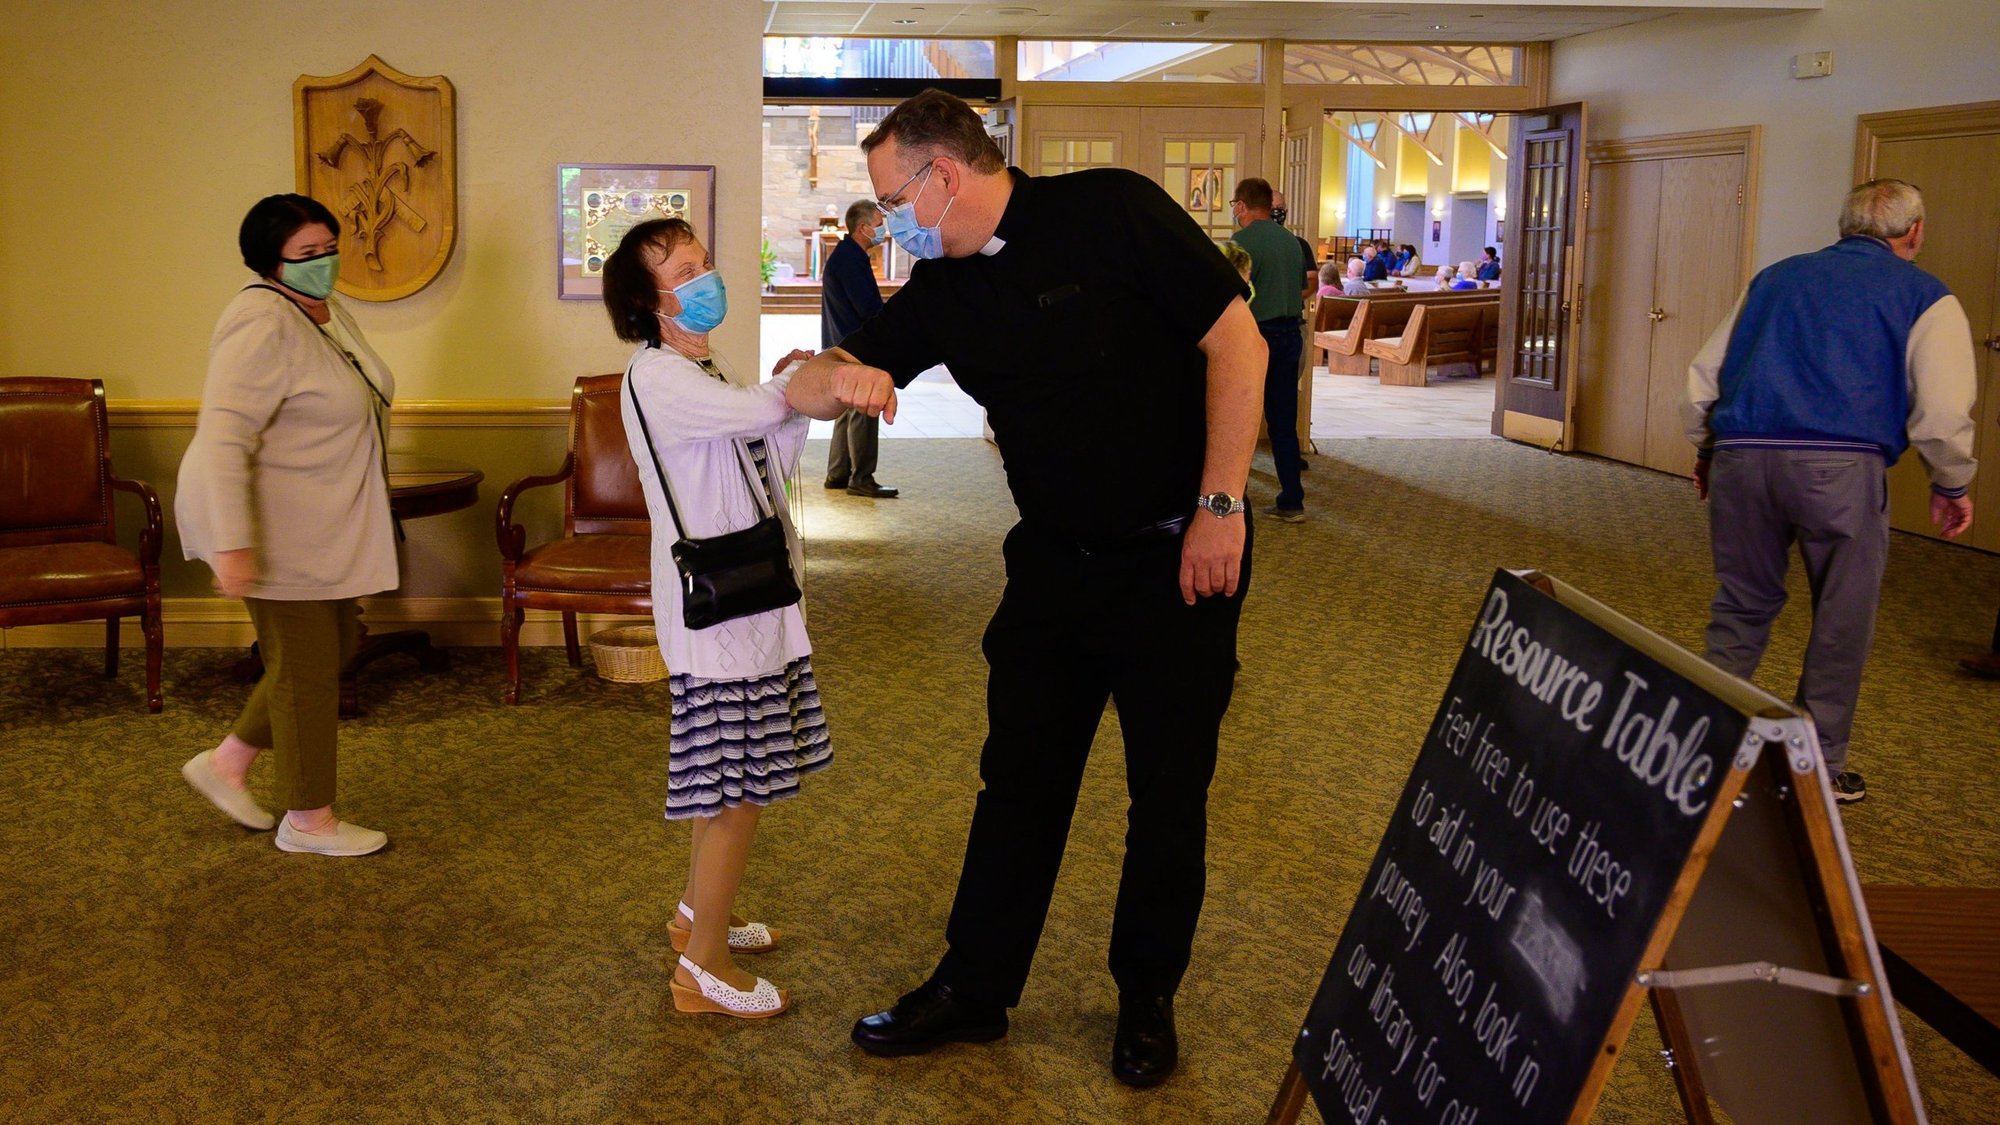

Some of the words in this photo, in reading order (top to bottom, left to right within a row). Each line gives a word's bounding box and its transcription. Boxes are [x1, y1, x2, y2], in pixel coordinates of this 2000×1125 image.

[1471, 587, 1603, 732] Resource
[1602, 671, 1713, 816] Table
[1411, 780, 1434, 827] to
[1429, 803, 1466, 856] aid
[1438, 696, 1481, 757] Feel
[1471, 722, 1510, 794] free
[1507, 762, 1534, 818] to
[1531, 797, 1570, 855] use
[1568, 821, 1632, 919] these
[1452, 822, 1475, 877] in
[1463, 859, 1516, 921] your
[1347, 943, 1376, 989] our
[1369, 963, 1418, 1075] library
[1412, 1036, 1446, 1109] for
[1370, 848, 1430, 951] journey.
[1433, 933, 1474, 1024] Also,
[1473, 982, 1521, 1073] look
[1512, 1040, 1540, 1108] in
[1322, 1028, 1382, 1125] spiritual
